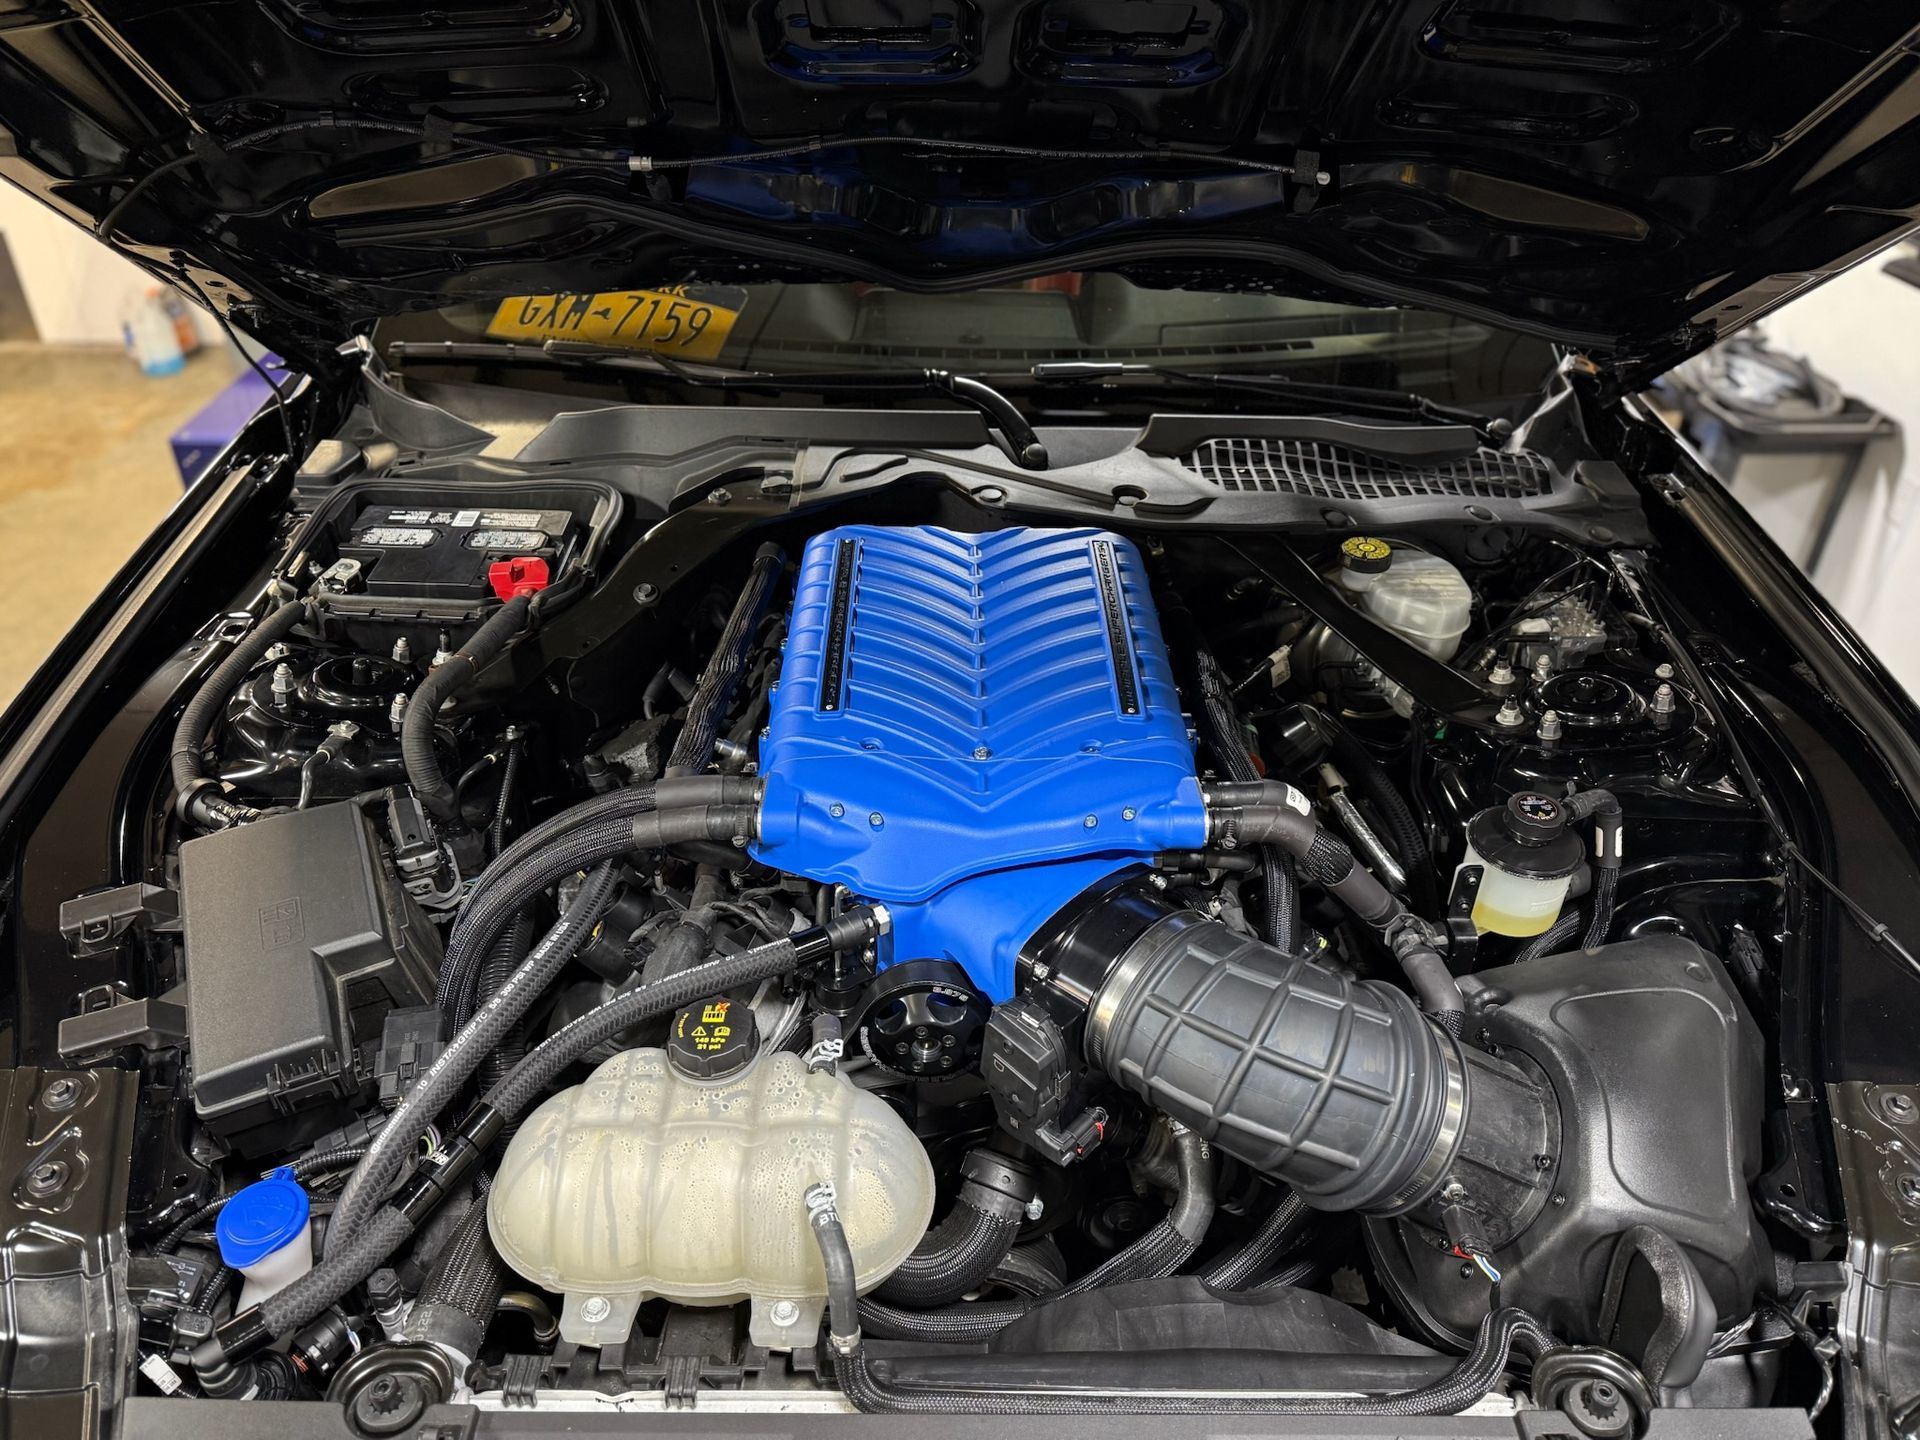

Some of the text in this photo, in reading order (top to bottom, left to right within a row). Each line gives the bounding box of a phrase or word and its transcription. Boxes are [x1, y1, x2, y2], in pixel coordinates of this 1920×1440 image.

[611, 295, 713, 347] 7159
[500, 983, 515, 997] 300
[511, 971, 526, 984] PSI
[533, 940, 554, 960] MADE
